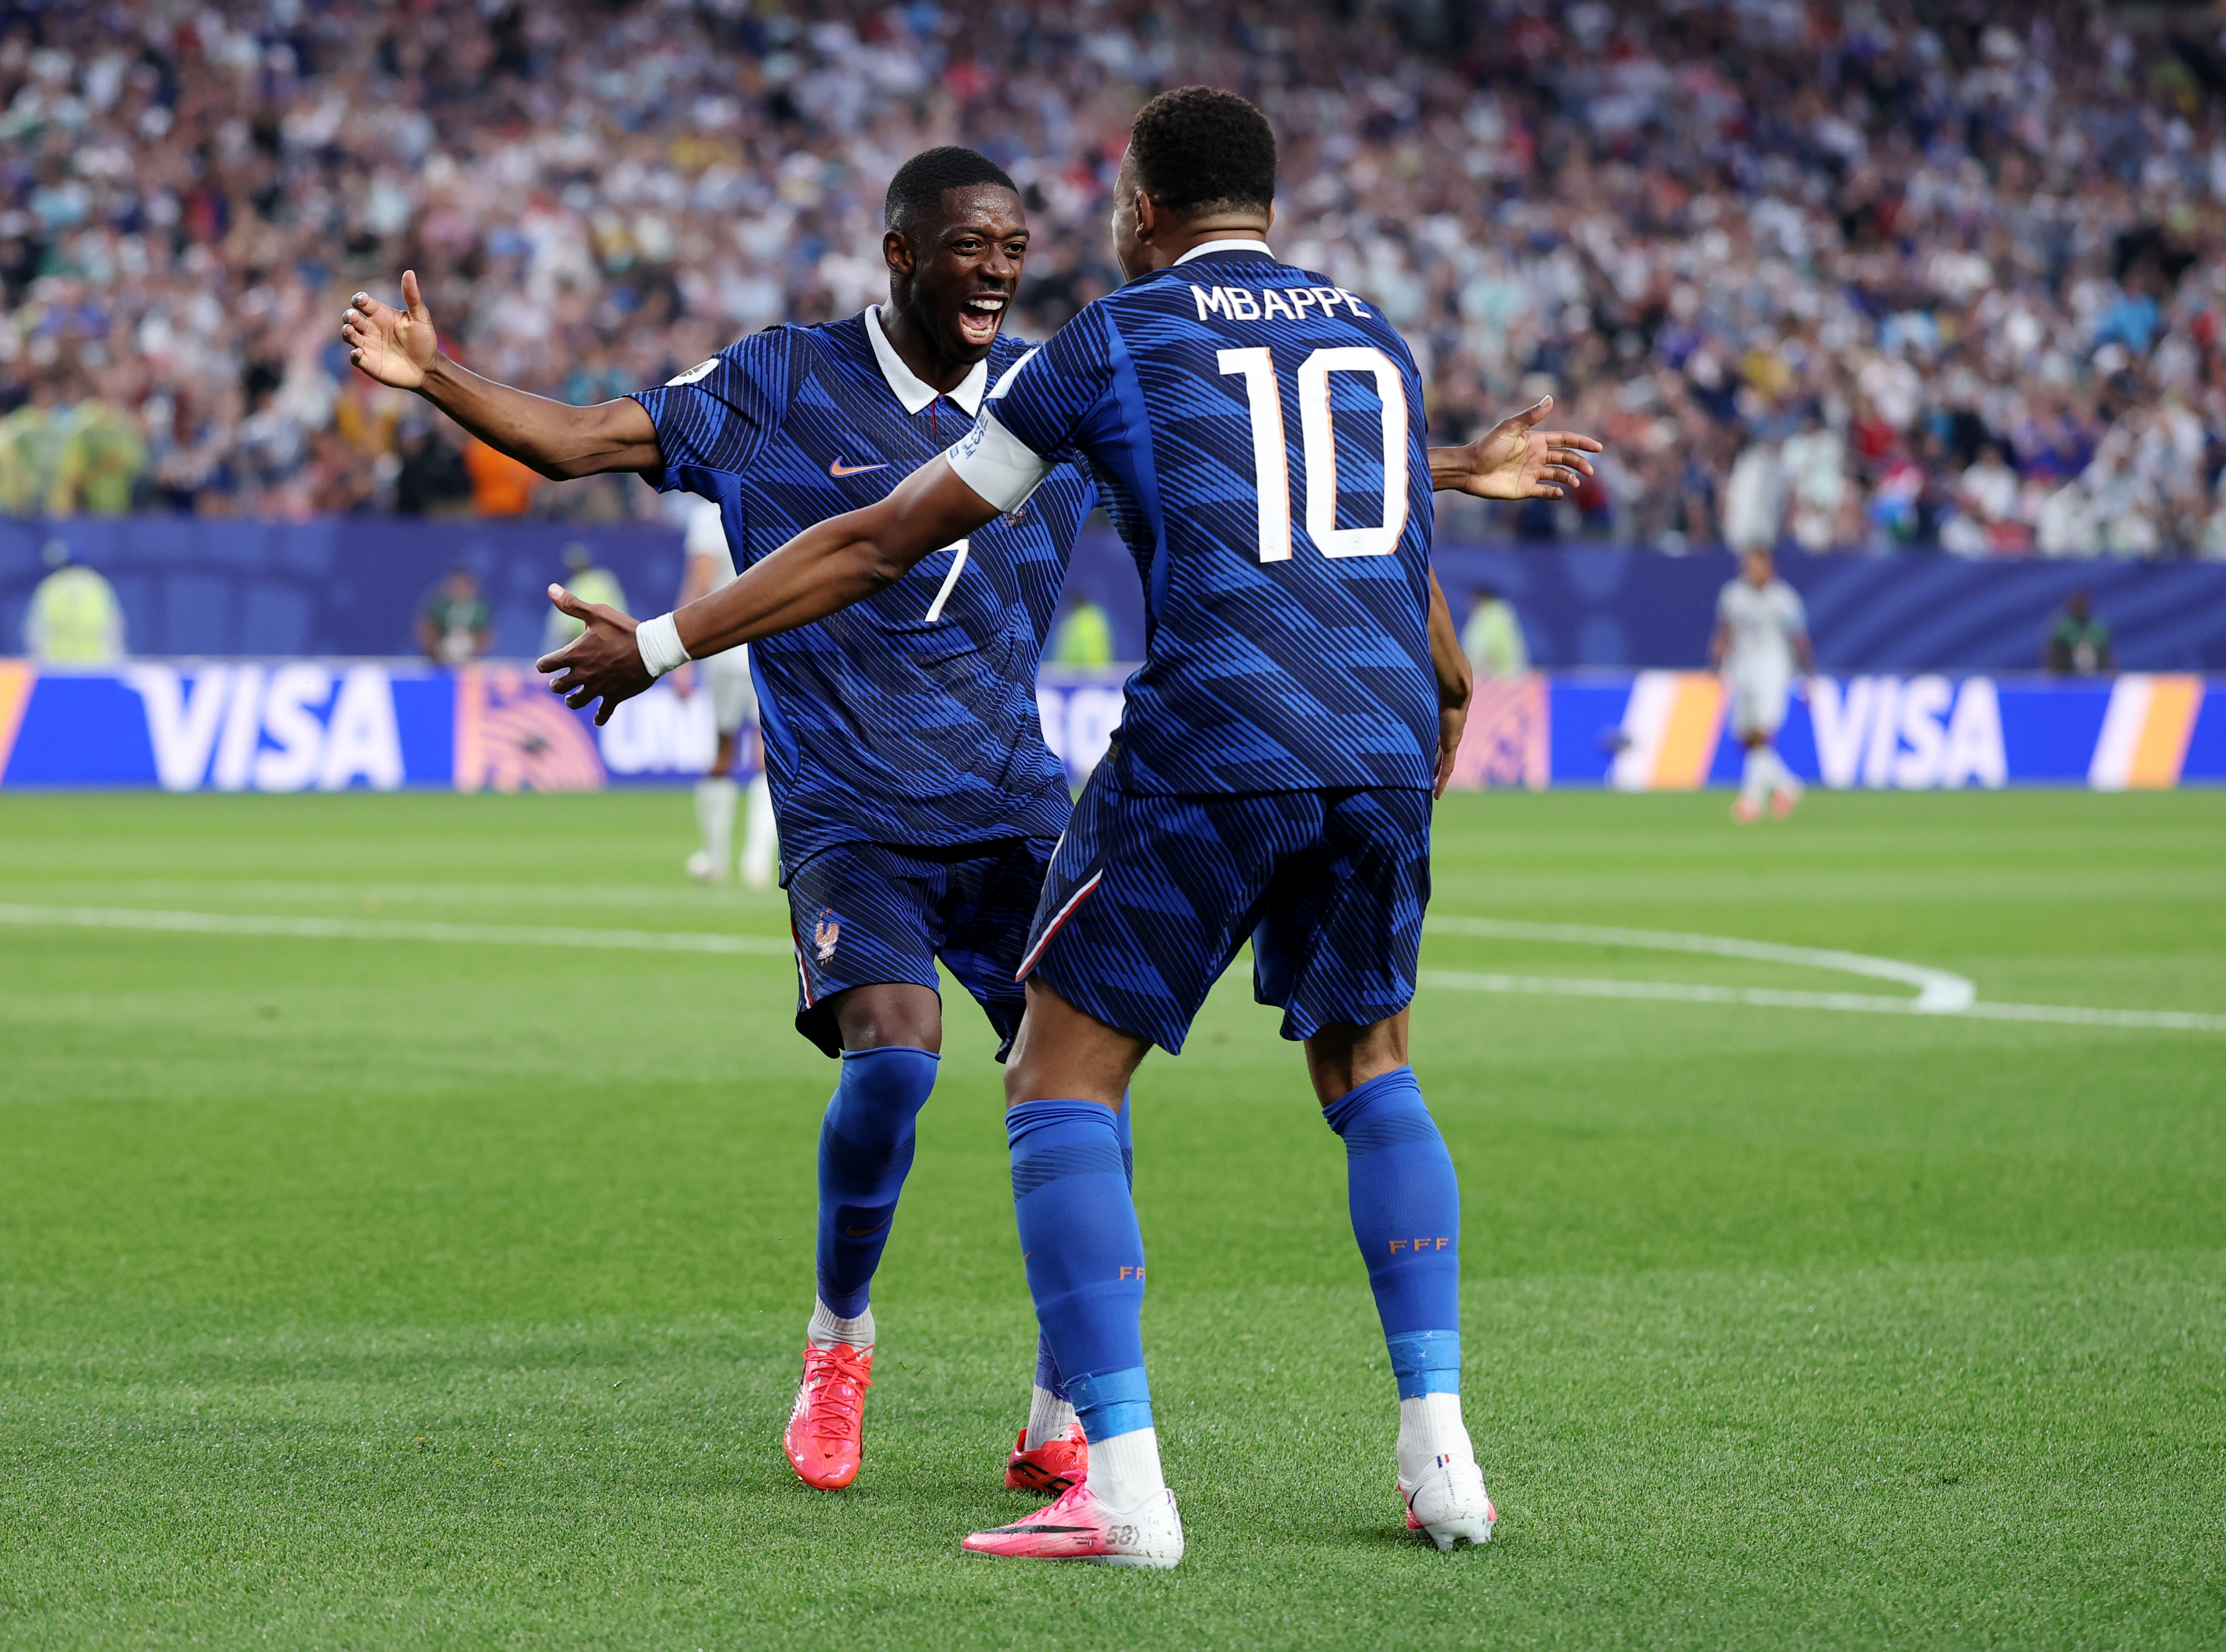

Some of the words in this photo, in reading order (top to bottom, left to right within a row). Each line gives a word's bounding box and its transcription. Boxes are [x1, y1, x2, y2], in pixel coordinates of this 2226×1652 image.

[1190, 285, 1372, 321] MBAPPE
[1217, 347, 1408, 563] 10
[925, 538, 969, 622] 7
[118, 662, 406, 792] VISA
[1808, 674, 2009, 790] VISA
[1389, 1237, 1449, 1255] FFF
